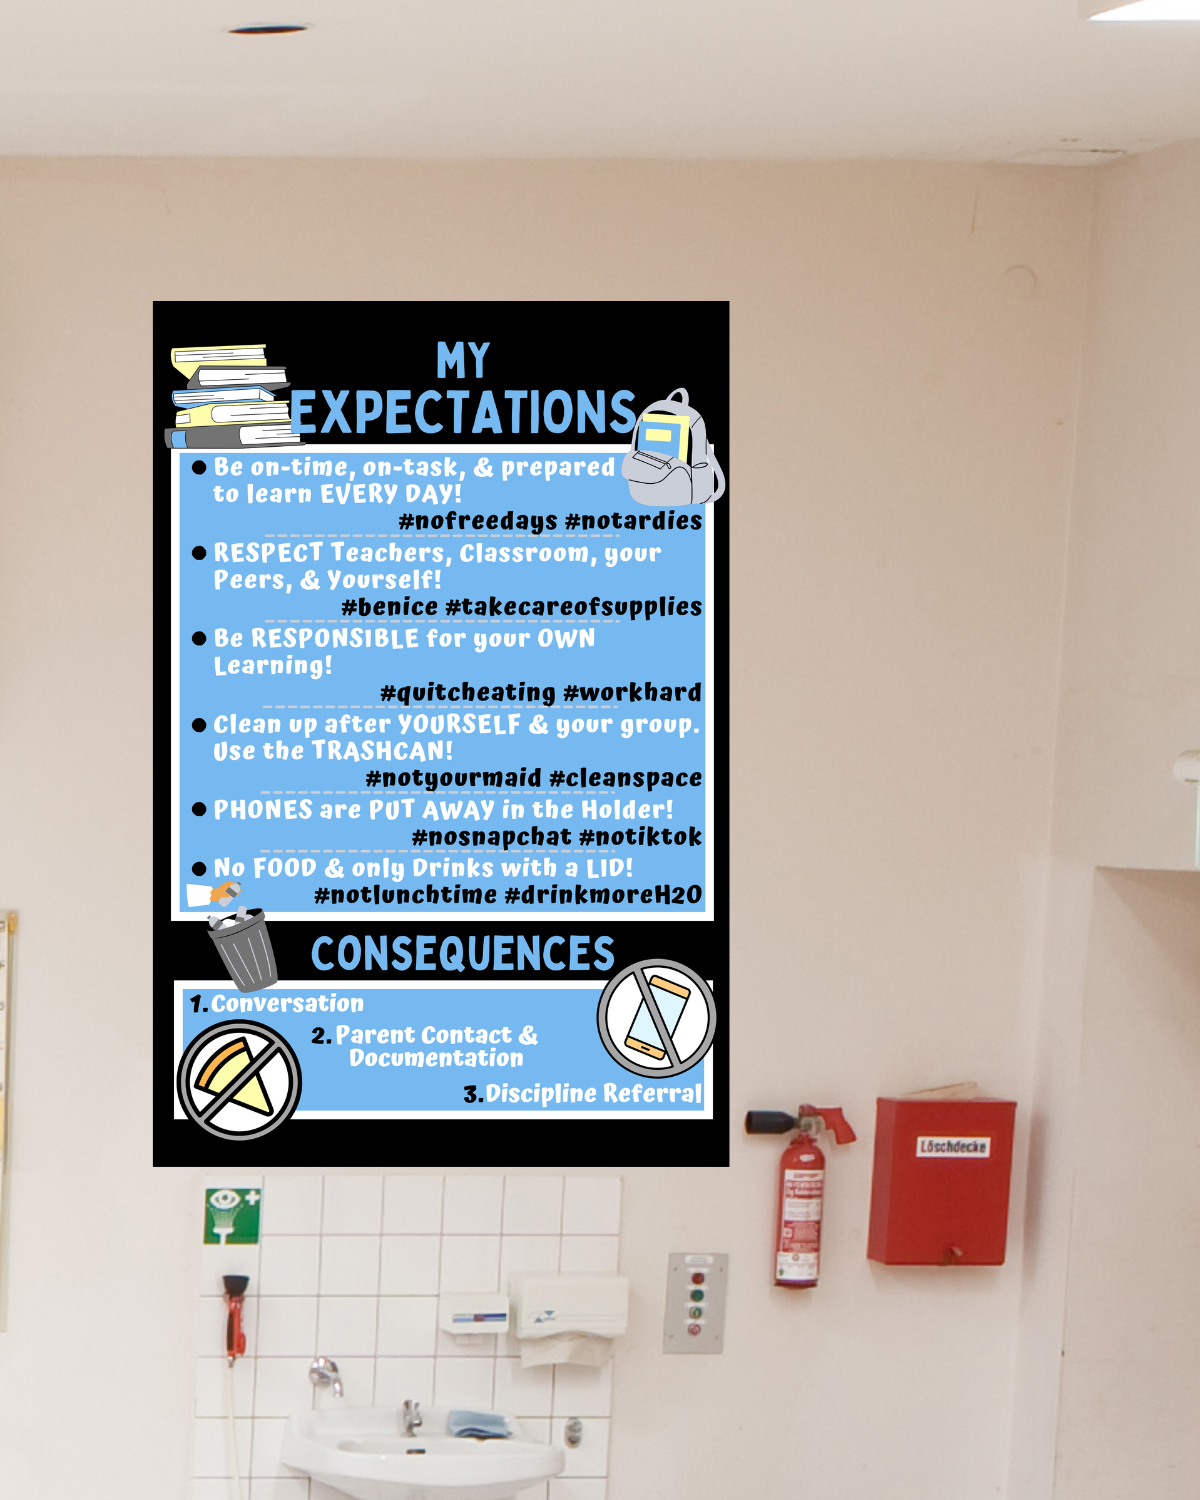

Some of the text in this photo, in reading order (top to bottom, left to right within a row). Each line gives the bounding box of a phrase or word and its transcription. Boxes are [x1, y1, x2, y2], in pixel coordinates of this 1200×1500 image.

[437, 341, 491, 379] MY
[290, 389, 637, 434] EXPECTATIONS
[214, 456, 615, 482] Be on-time, on-task, & prepared
[212, 482, 462, 506] to learn EVERY DAY!
[398, 509, 703, 535] #nofreedays #notardies
[214, 541, 662, 568] RESPECT Teachers, Classroom, your
[214, 569, 442, 595] Peers, & Yourself!
[341, 595, 703, 621] #benice #takecareofsupplies
[214, 627, 595, 654] Be RESPONSIBLE for your OWN
[214, 654, 332, 680] Learning!
[380, 681, 702, 707] #quitcheating #workhard
[213, 712, 700, 739] Clean up after YOURSELF & your group.
[213, 738, 453, 763] Use the TRASHCAN!
[365, 766, 702, 792] #notyourmaid #cleanspace
[214, 797, 673, 822] PHONES are PUT AWAY in the Holder!
[411, 825, 703, 851] #nosnapchat #notiktok
[214, 856, 633, 883] No FOOD & only Drinks with a LID!
[314, 883, 497, 905] #notlunchtime
[311, 934, 616, 973] CONSEQUENCES
[311, 1024, 539, 1046] 2. Parent Contact &
[349, 1047, 524, 1068] Documentation
[603, 1082, 702, 1104] Referral
[920, 1139, 987, 1154] Löschdecke
